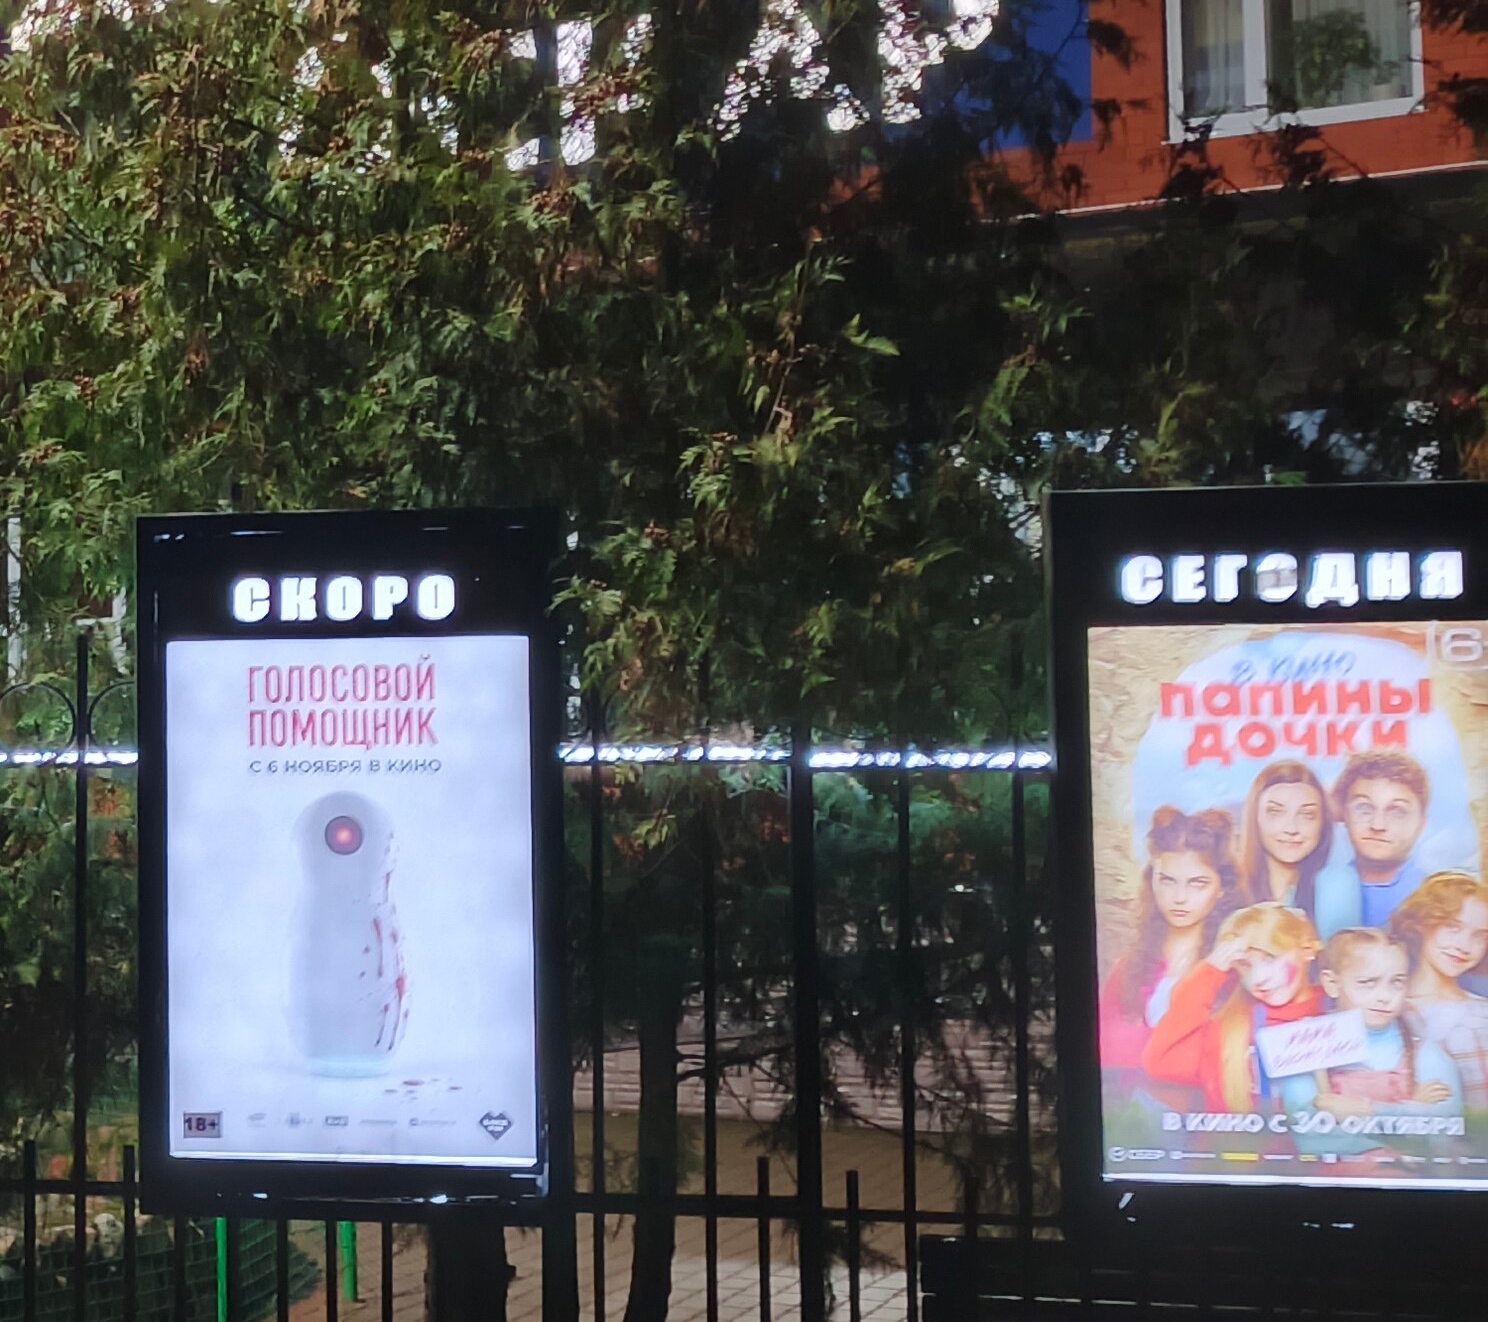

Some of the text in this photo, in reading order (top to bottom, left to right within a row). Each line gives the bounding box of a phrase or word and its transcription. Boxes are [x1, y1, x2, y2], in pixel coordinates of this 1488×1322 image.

[234, 575, 455, 622] СКОРО
[1121, 551, 1463, 608] СЕГОДНЯ
[247, 653, 436, 704] ГОЛОСОВОЙ
[248, 707, 439, 751] ПОМОЩНИК
[249, 758, 443, 774] С 6 НОЯБРЯ В КИНО
[183, 1116, 220, 1132] 18+
[1163, 1112, 1183, 1132] В
[1186, 1112, 1264, 1133] КИНО
[1292, 1110, 1336, 1134] 30
[1340, 1115, 1465, 1135] ОКТЯБРЯ
